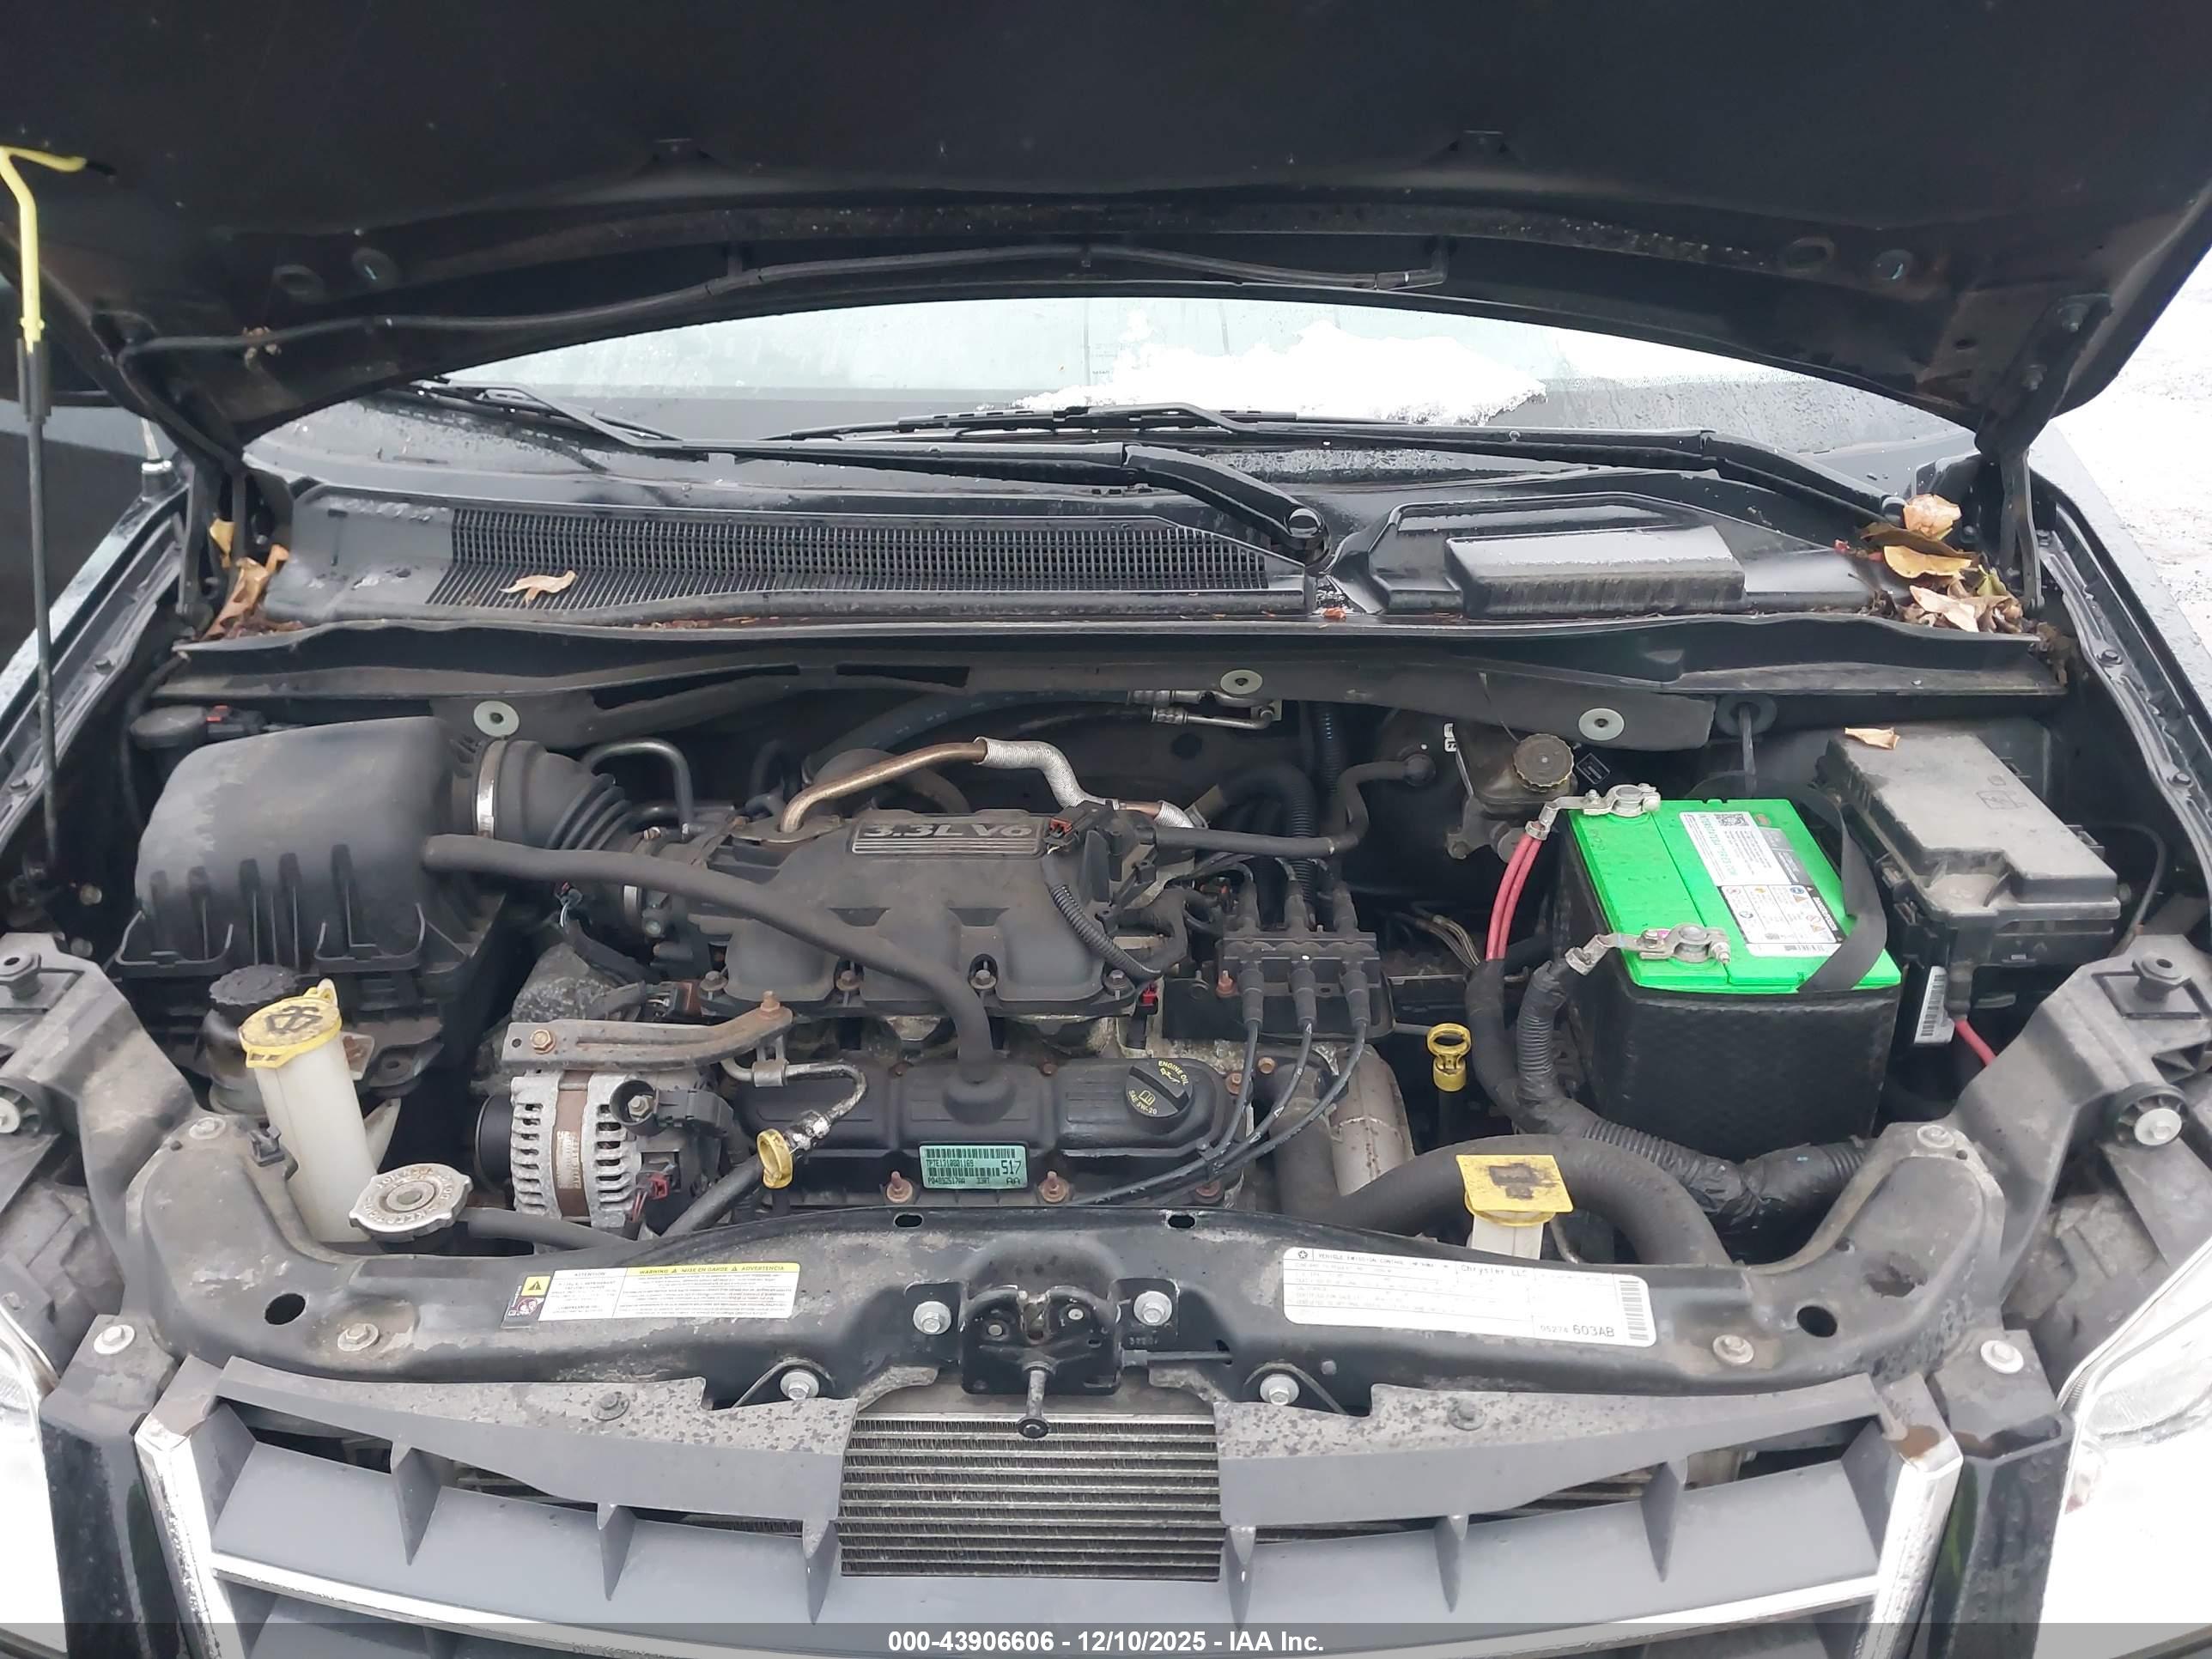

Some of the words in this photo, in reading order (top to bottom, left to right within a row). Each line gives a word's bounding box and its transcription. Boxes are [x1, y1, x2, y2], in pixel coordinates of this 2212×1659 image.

[863, 823, 963, 837] 3.3L
[972, 823, 1032, 837] V6
[1158, 1060, 1183, 1075] ENGINE
[1180, 1074, 1189, 1086] OIL
[1128, 1090, 1139, 1103] SAE
[1136, 1101, 1158, 1115] 5W-20
[1000, 1160, 1022, 1175] 517
[1006, 1176, 1021, 1185] AA
[1346, 1255, 1377, 1263] EMISSION
[1461, 1264, 1504, 1276] Chrysler
[1511, 1268, 1528, 1277] LLC
[1572, 1324, 1615, 1337] 603AB
